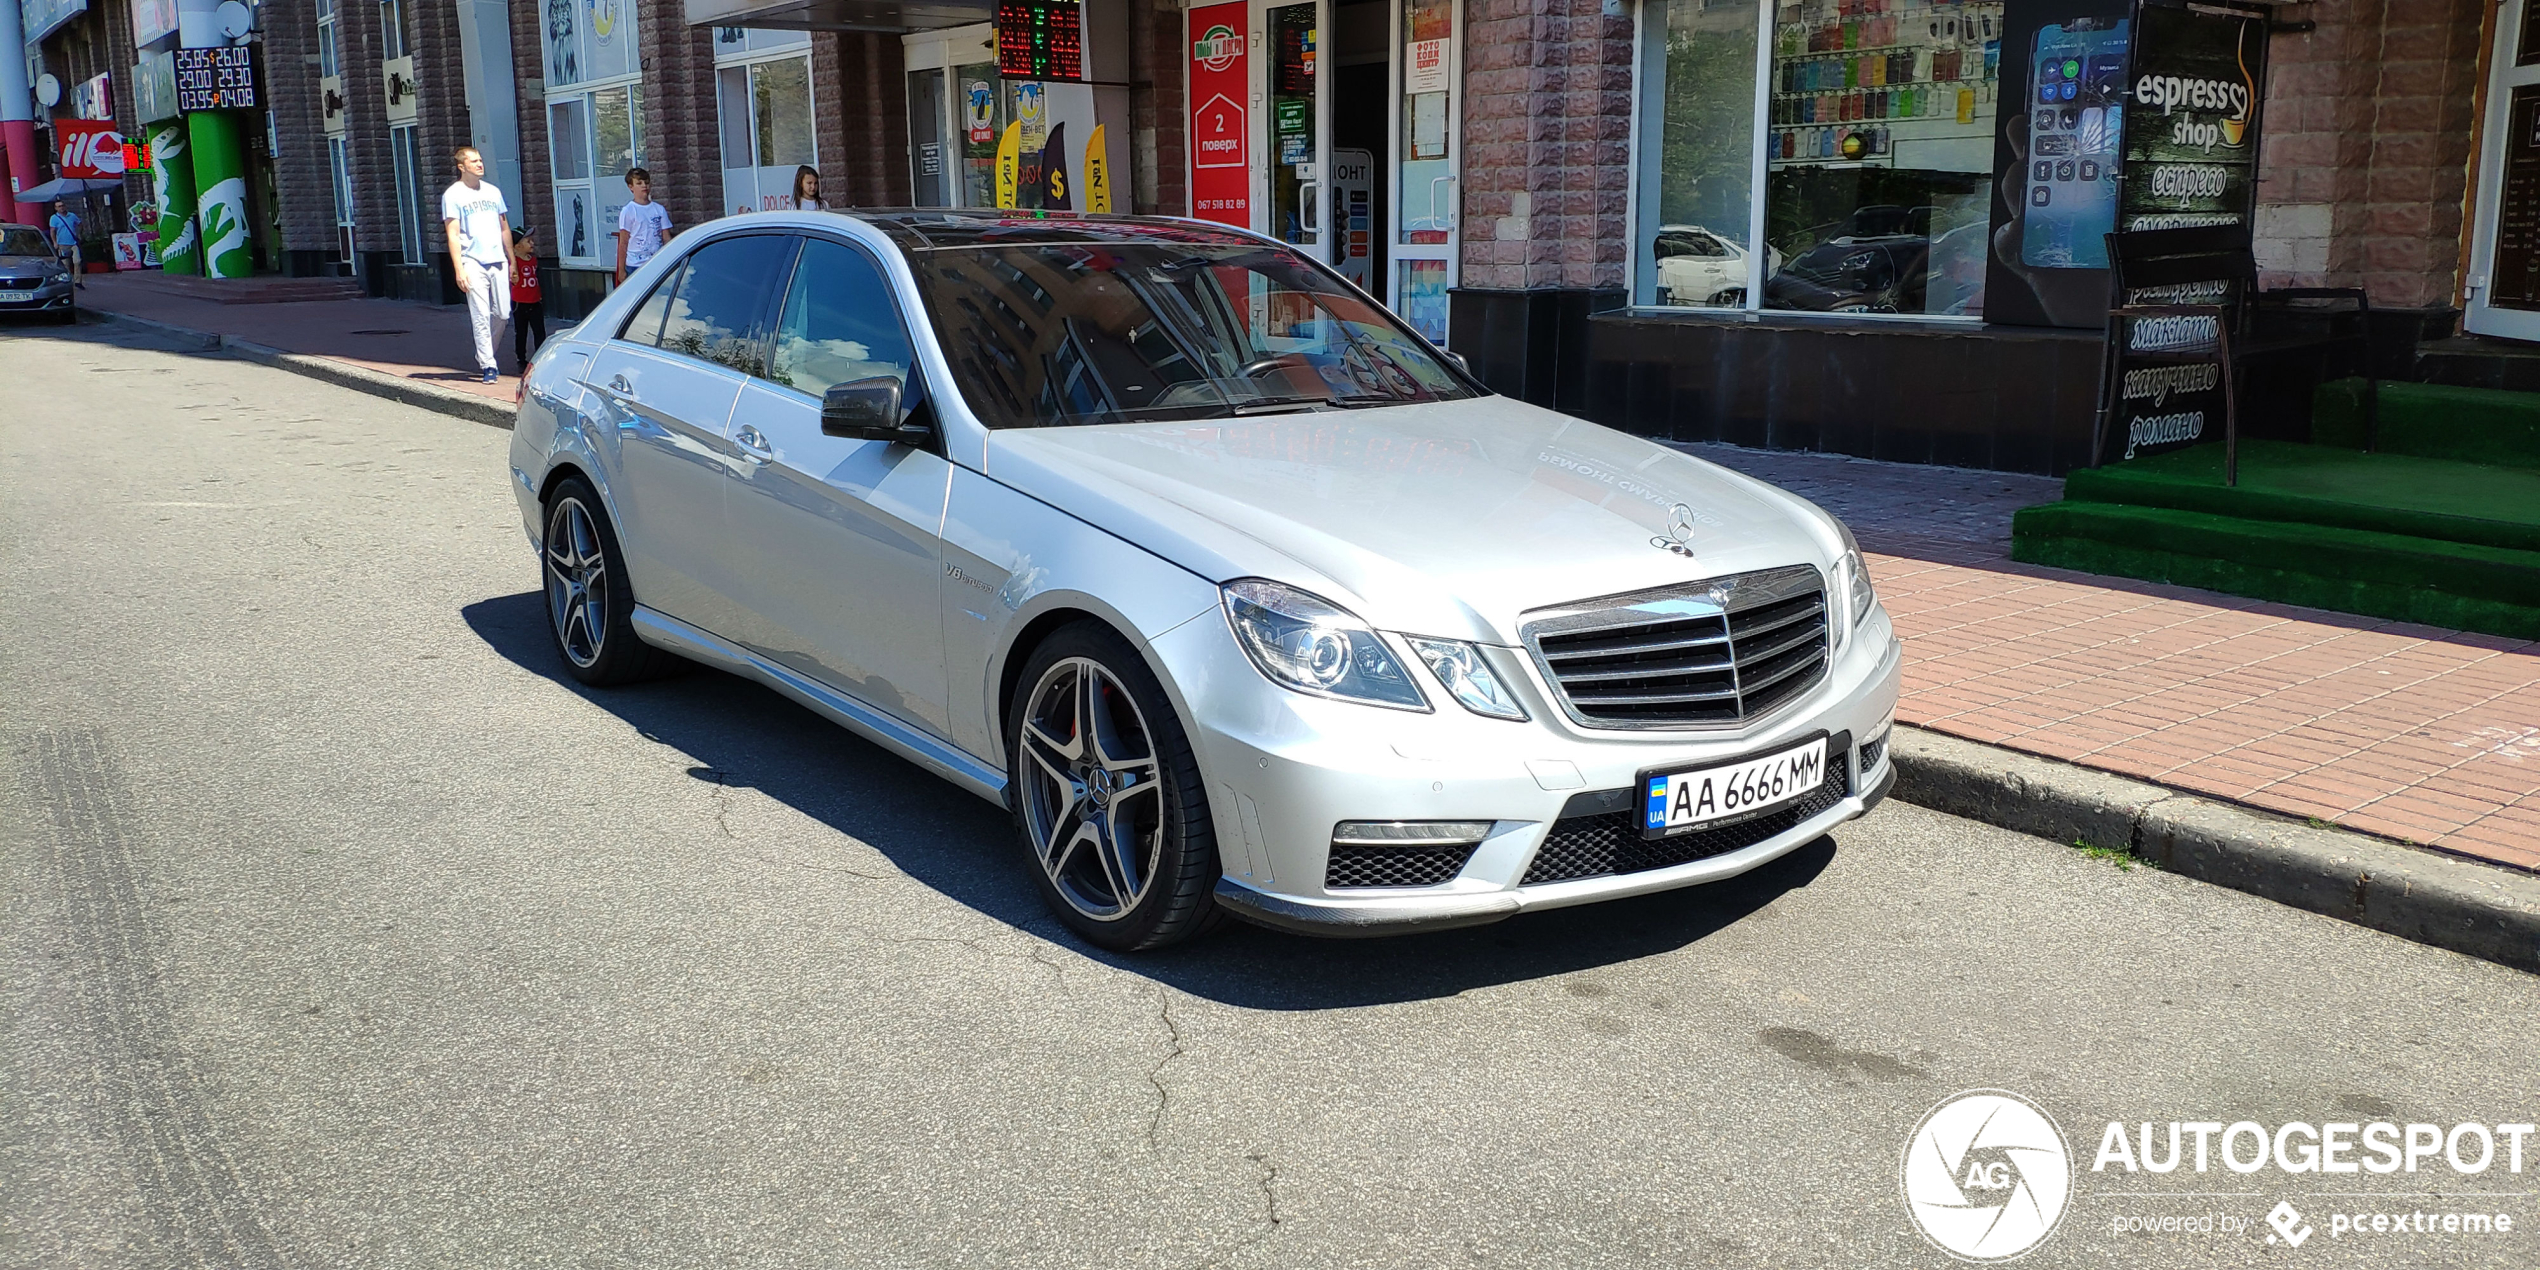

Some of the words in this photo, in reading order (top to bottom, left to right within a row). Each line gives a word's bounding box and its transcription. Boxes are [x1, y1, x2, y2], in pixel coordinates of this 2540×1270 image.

[1417, 41, 1440, 51] ФОТО
[1417, 50, 1440, 60] КОПИ
[177, 49, 210, 69] 25.85
[216, 46, 250, 67] 26.00
[1417, 59, 1440, 70] ЦЕНТР
[179, 69, 212, 89] 29.00
[218, 67, 252, 87] 29.30
[180, 89, 215, 110] 03.95
[220, 87, 254, 108] 04.08
[1215, 113, 1225, 133] 2
[2172, 112, 2217, 153] shop
[1202, 139, 1238, 153] поверх
[1050, 167, 1065, 200] $
[1197, 200, 1211, 209] 067
[1212, 200, 1224, 209] 518
[1225, 199, 1235, 209] 82
[1236, 199, 1246, 209] 89
[2123, 363, 2218, 407] капучино
[2124, 411, 2203, 459] романо
[1671, 777, 1715, 821] AA
[1724, 759, 1785, 810] 6666
[1788, 746, 1821, 793] MM
[1649, 810, 1665, 824] UA
[1712, 815, 1742, 828] Performance
[1742, 811, 1758, 823] Center
